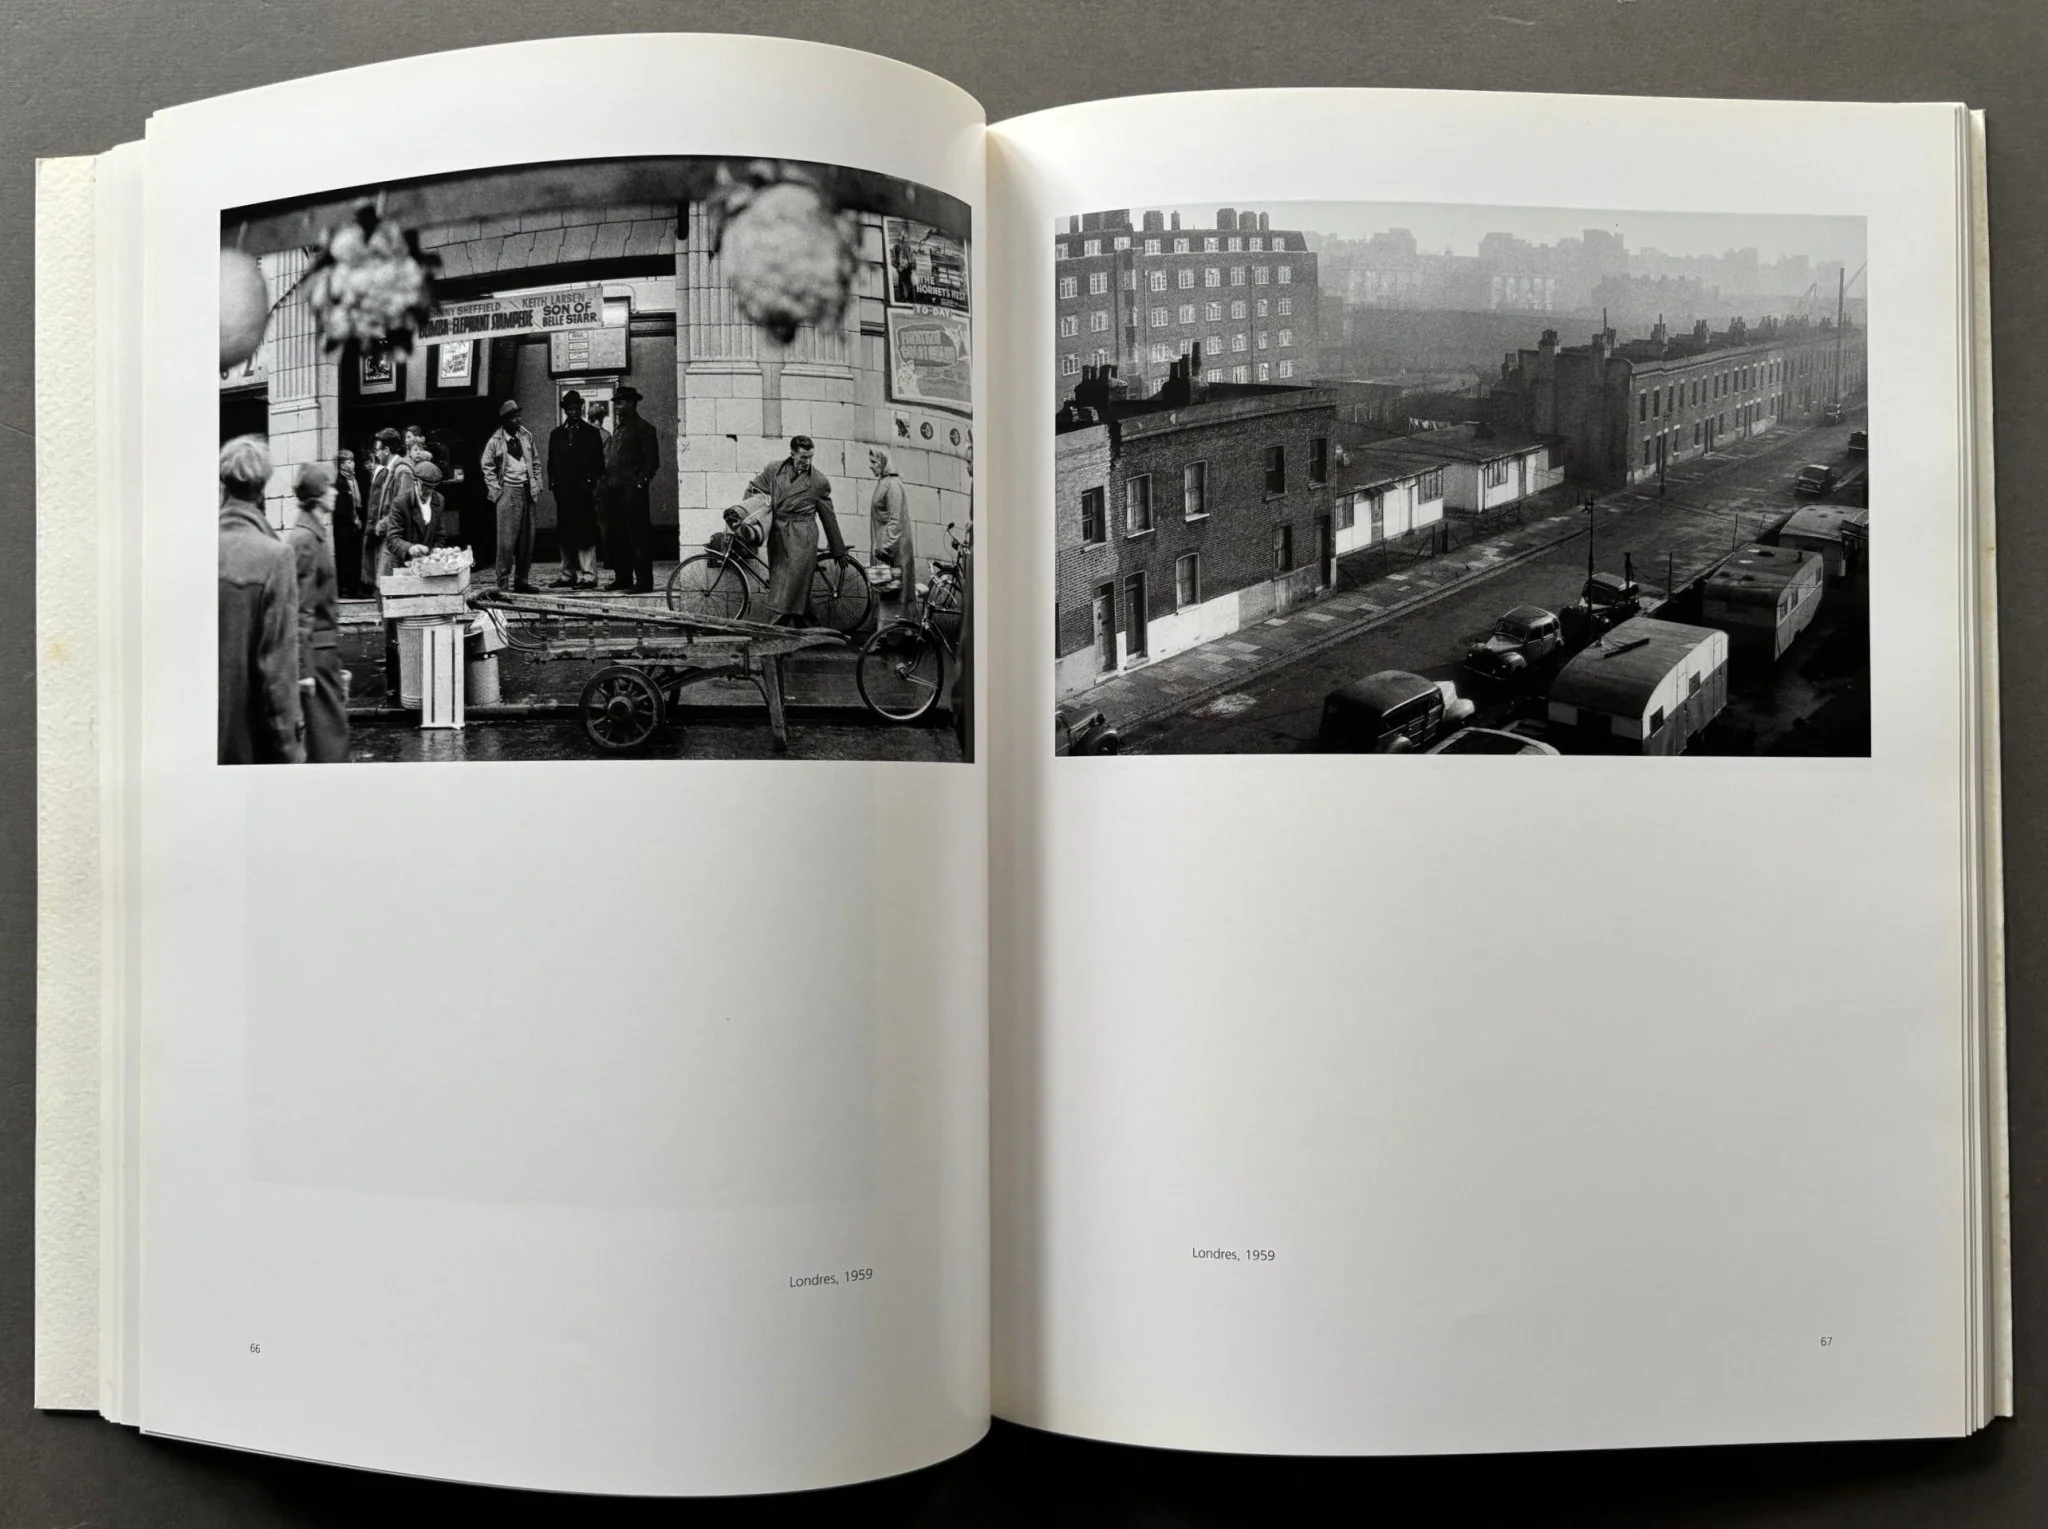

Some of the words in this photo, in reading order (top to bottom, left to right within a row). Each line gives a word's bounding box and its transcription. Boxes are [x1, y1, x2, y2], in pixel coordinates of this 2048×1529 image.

[522, 295, 547, 309] KEITH
[550, 292, 585, 305] LARSEN
[456, 302, 501, 316] SHEFFIELD
[543, 303, 570, 316] SON
[574, 301, 592, 314] OF
[915, 304, 951, 318] TO-DAY
[542, 315, 564, 327] BELLE
[566, 312, 597, 325] STARR
[1192, 1247, 1240, 1261] Londres,
[1246, 1249, 1275, 1261] 1959
[789, 1273, 839, 1288] Londres,
[844, 1268, 873, 1282] 1959
[250, 1343, 261, 1353] 66
[1820, 1336, 1833, 1346] 67
